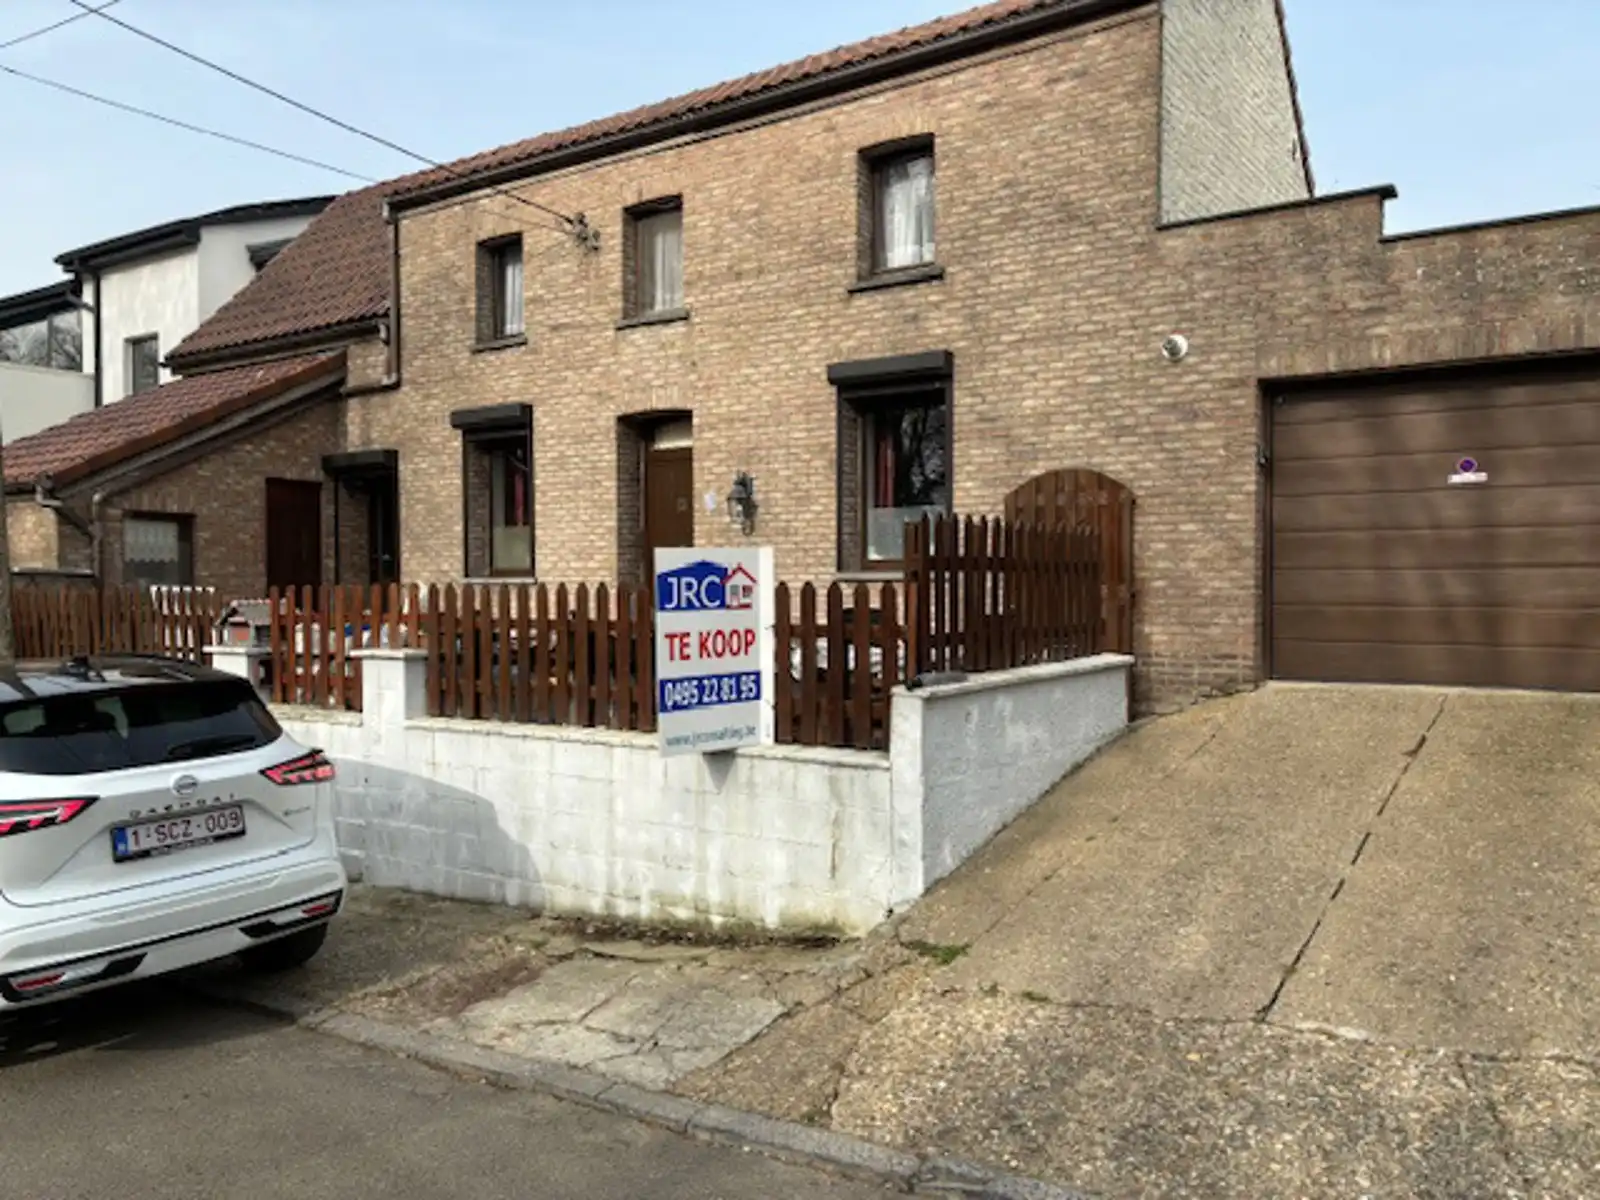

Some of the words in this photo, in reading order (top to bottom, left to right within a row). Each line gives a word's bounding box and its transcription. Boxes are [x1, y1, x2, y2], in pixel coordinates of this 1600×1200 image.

[664, 575, 721, 608] JRC
[664, 632, 691, 662] TE
[699, 628, 756, 659] KOOP
[702, 678, 719, 703] 22
